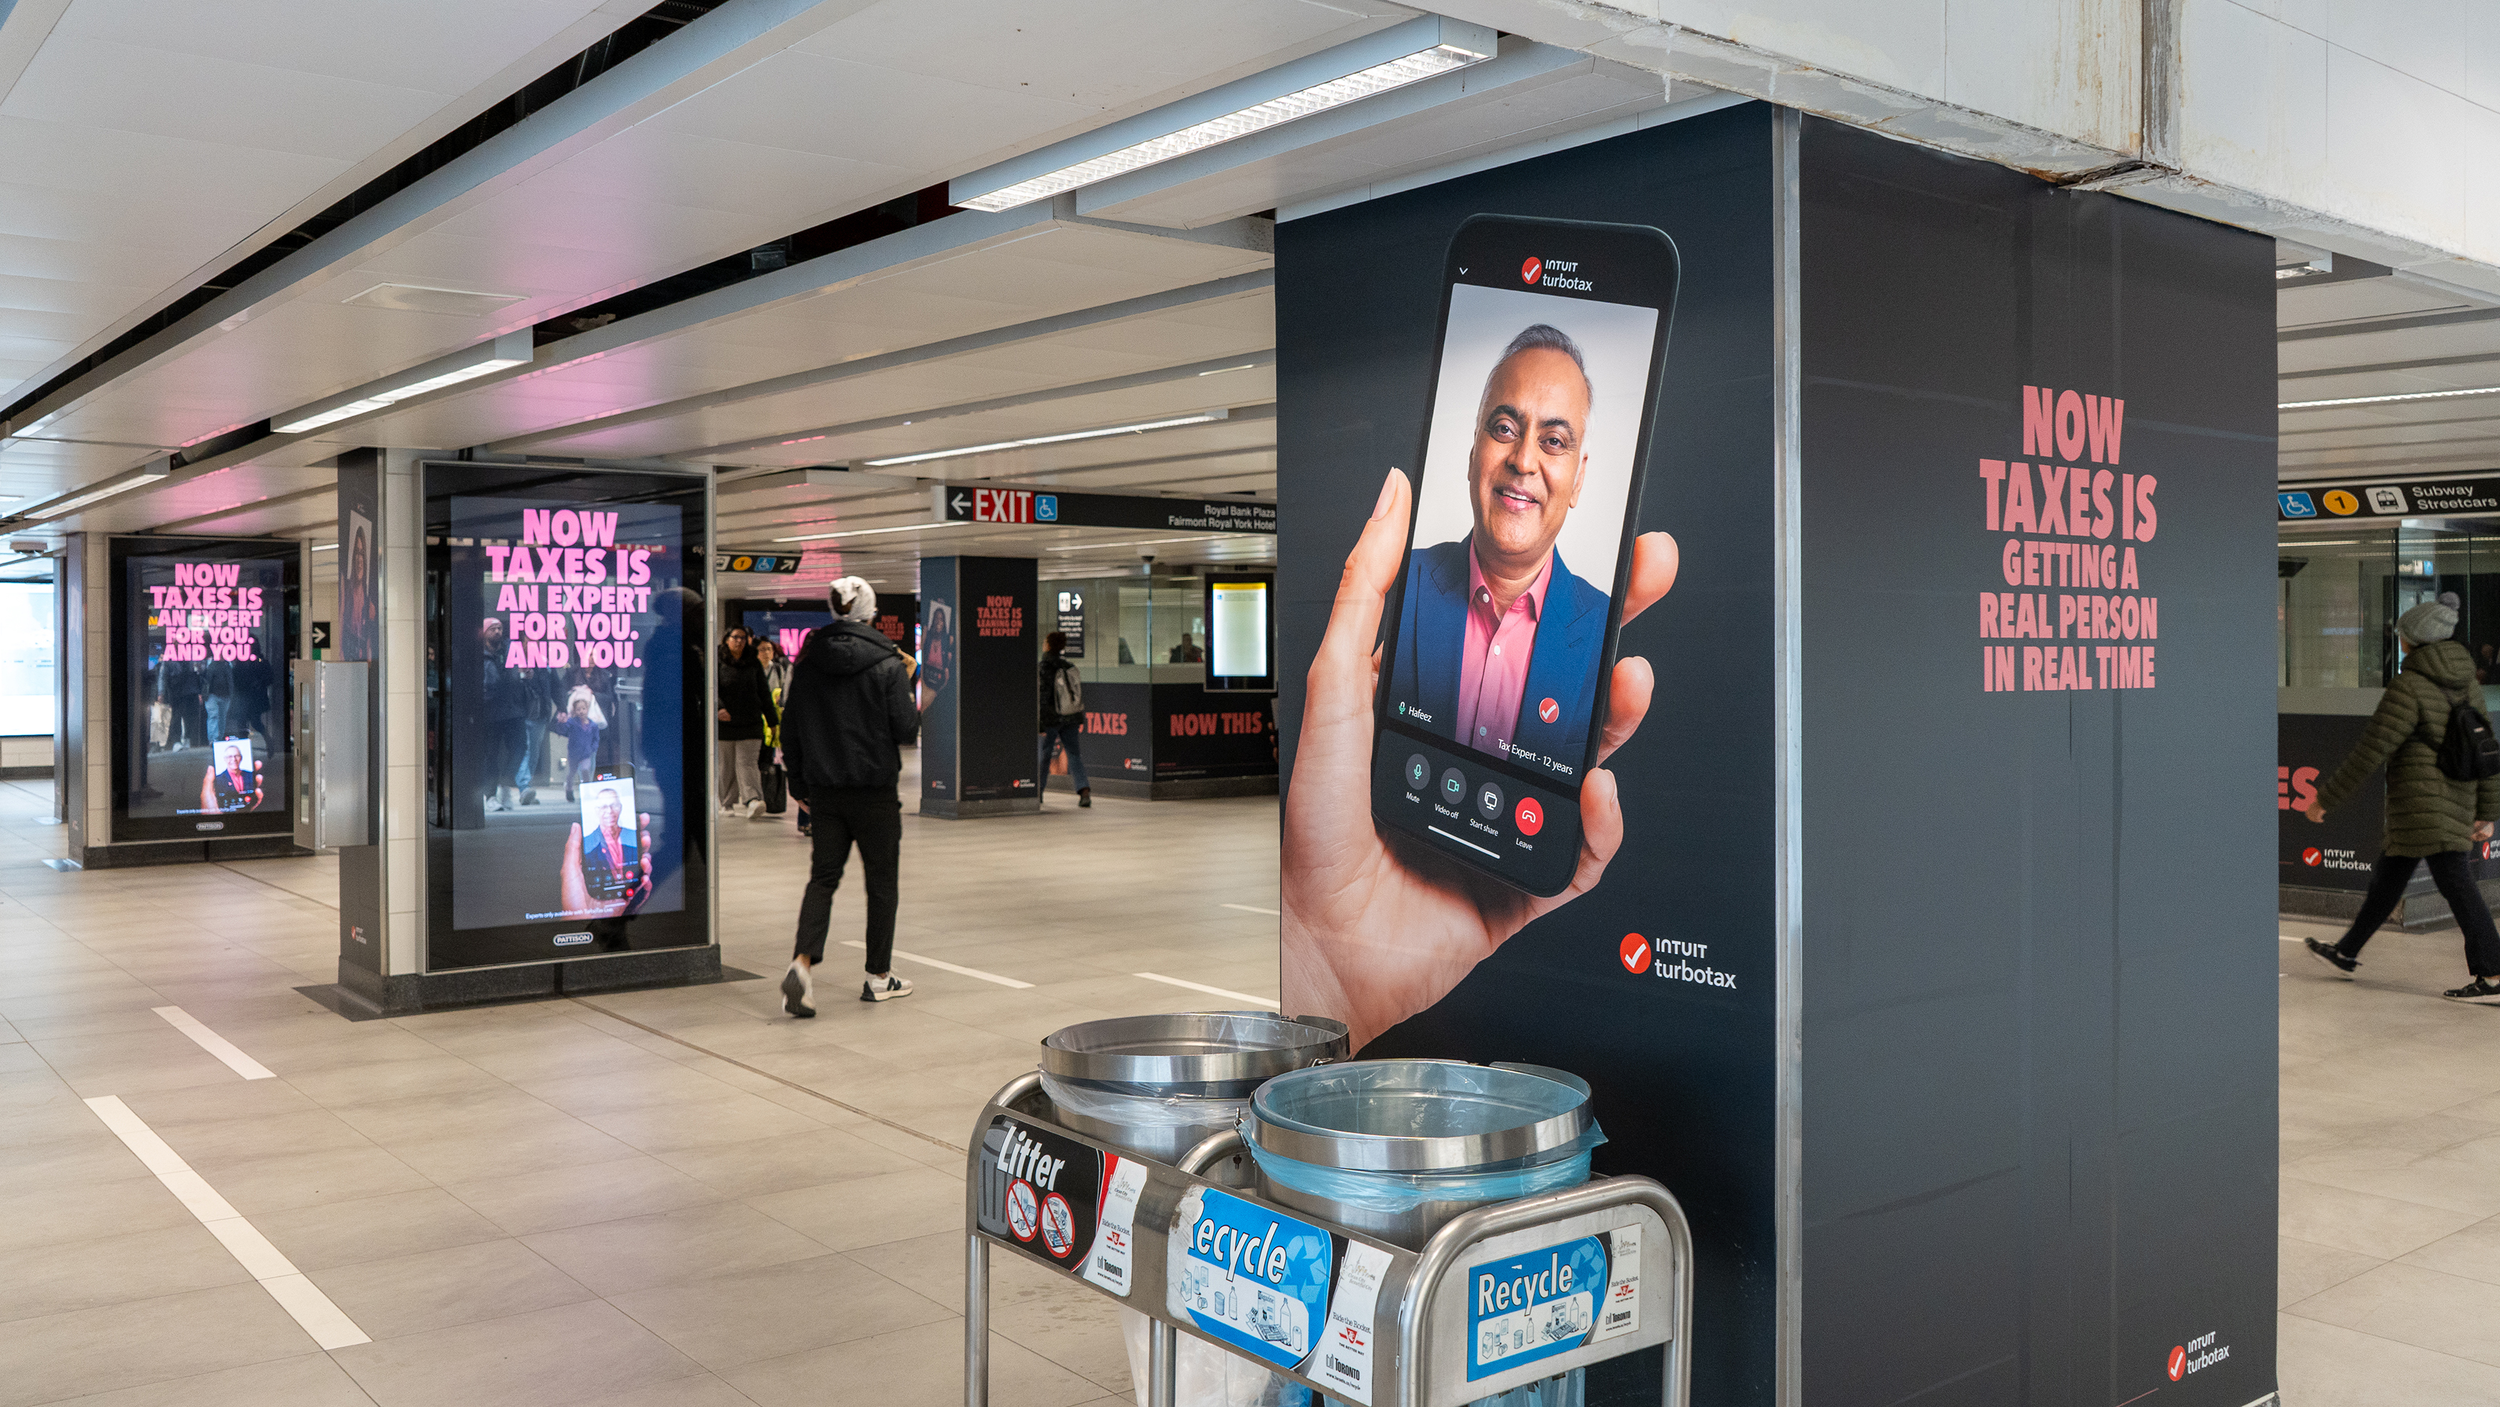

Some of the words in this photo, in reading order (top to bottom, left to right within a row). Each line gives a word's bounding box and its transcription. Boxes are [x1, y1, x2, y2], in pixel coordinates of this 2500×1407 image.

[1545, 259, 1578, 272] INTUIT
[1542, 273, 1593, 292] turbotax
[2023, 385, 2124, 465] NOW
[1980, 458, 2115, 540] TAXES
[2122, 473, 2158, 543] IS
[2412, 485, 2474, 498] Subway
[975, 488, 1032, 523] EXIT
[1204, 504, 1228, 518] Royal
[1230, 506, 1252, 516] Bank
[1253, 507, 1276, 518] Plaza
[2334, 496, 2346, 510] 1
[2417, 497, 2498, 510] Streetcars
[523, 508, 618, 547] NOW
[1168, 515, 1207, 528] Fairmont
[1208, 518, 1232, 530] Royal
[1234, 519, 1252, 530] York
[1254, 519, 1276, 530] Hotel
[486, 546, 607, 585] TAXES
[616, 548, 652, 586] IS
[2002, 538, 2116, 590] GETTING
[2120, 546, 2139, 590] A
[174, 563, 240, 587] NOW
[150, 586, 232, 610] TAXES
[238, 587, 263, 610] IS
[496, 584, 538, 612] AN
[548, 585, 652, 613] EXPERT
[986, 595, 1014, 608] NOW
[157, 610, 186, 627] AN
[192, 610, 263, 628] EXPERT
[977, 607, 1010, 619] TAXES
[1012, 607, 1022, 619] IS
[1980, 592, 2053, 638] REAL
[2060, 594, 2158, 640] PERSON
[510, 612, 567, 640] FOR
[572, 613, 640, 641] YOU.
[976, 619, 1010, 628] LEANING
[1010, 619, 1022, 628] ON
[979, 628, 991, 636] AN
[992, 628, 1020, 636] EXPERT
[166, 627, 205, 644] FOR
[208, 627, 254, 644] YOU.
[163, 644, 207, 662] AND
[210, 644, 257, 662] YOU.
[505, 641, 569, 668] AND
[574, 641, 642, 668] YOU.
[1984, 646, 2015, 692] IN
[2024, 646, 2092, 692] REAL
[2096, 646, 2156, 690] TIME
[1086, 712, 1128, 736] TAXES
[1170, 713, 1218, 737] NOW
[1221, 711, 1262, 734] THIS
[1408, 706, 1432, 723] Hafeez
[1498, 738, 1510, 752] Tax
[1512, 744, 1536, 763] Expert
[1543, 755, 1552, 768] 12
[1552, 760, 1574, 775] years
[1406, 792, 1420, 804] Mute
[1434, 804, 1450, 817] Video
[1451, 811, 1460, 820] off
[1470, 818, 1483, 830] Start
[1484, 825, 1499, 836] share
[1516, 838, 1533, 851] Leave
[2324, 848, 2356, 858] INTUIT
[2323, 858, 2372, 872] turbotax
[1656, 938, 1708, 958] INTUIT
[1654, 959, 1736, 990] turbotax
[996, 1125, 1066, 1192] Litter
[1478, 1252, 1573, 1318] Recycle
[1332, 1312, 1344, 1323] Ride
[1344, 1316, 1353, 1326] the
[2188, 1331, 2216, 1354] INTUIT
[1334, 1358, 1360, 1381] TORONTO
[2187, 1346, 2230, 1374] turbotax
